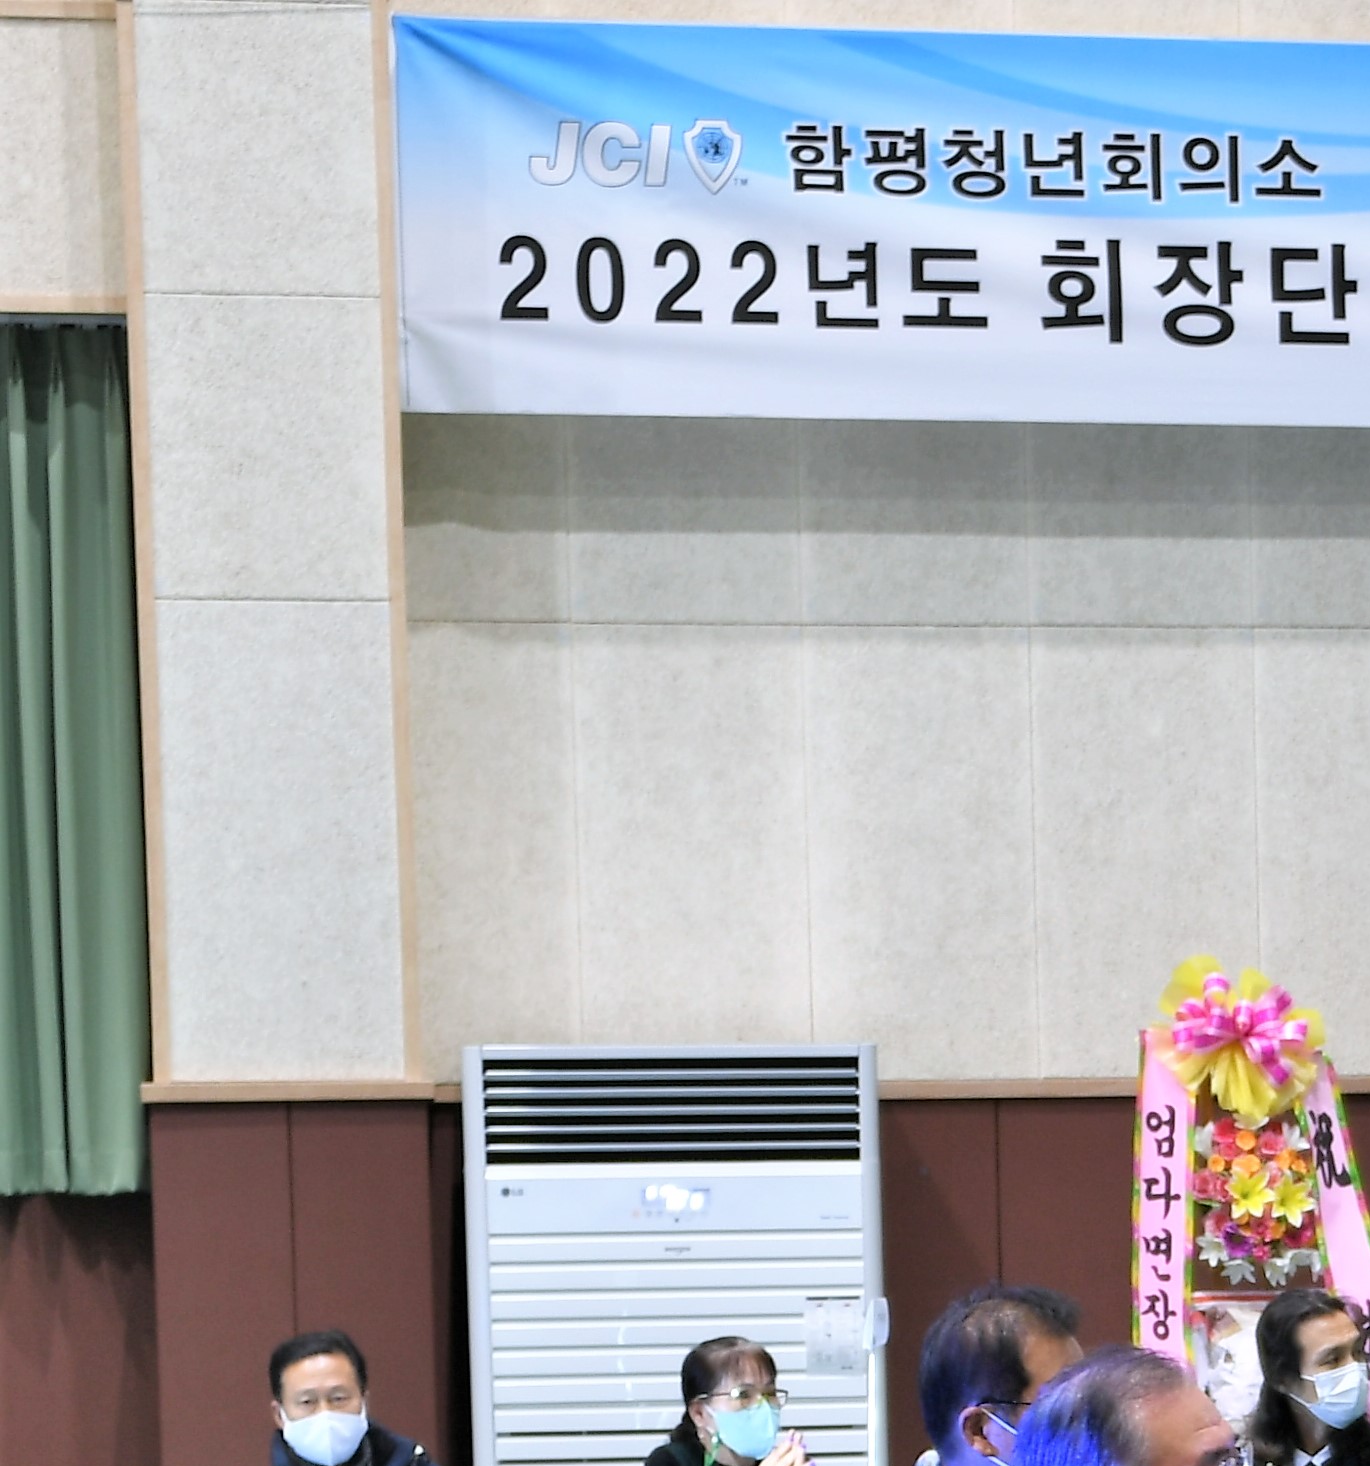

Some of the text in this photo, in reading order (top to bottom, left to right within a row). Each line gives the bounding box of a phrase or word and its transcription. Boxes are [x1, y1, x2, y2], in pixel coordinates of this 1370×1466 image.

[529, 120, 672, 188] JCI
[784, 123, 1325, 202] 함평청년회의소
[498, 234, 1359, 345] 2022년도 회장단
[1142, 1105, 1181, 1341] 엄다면장
